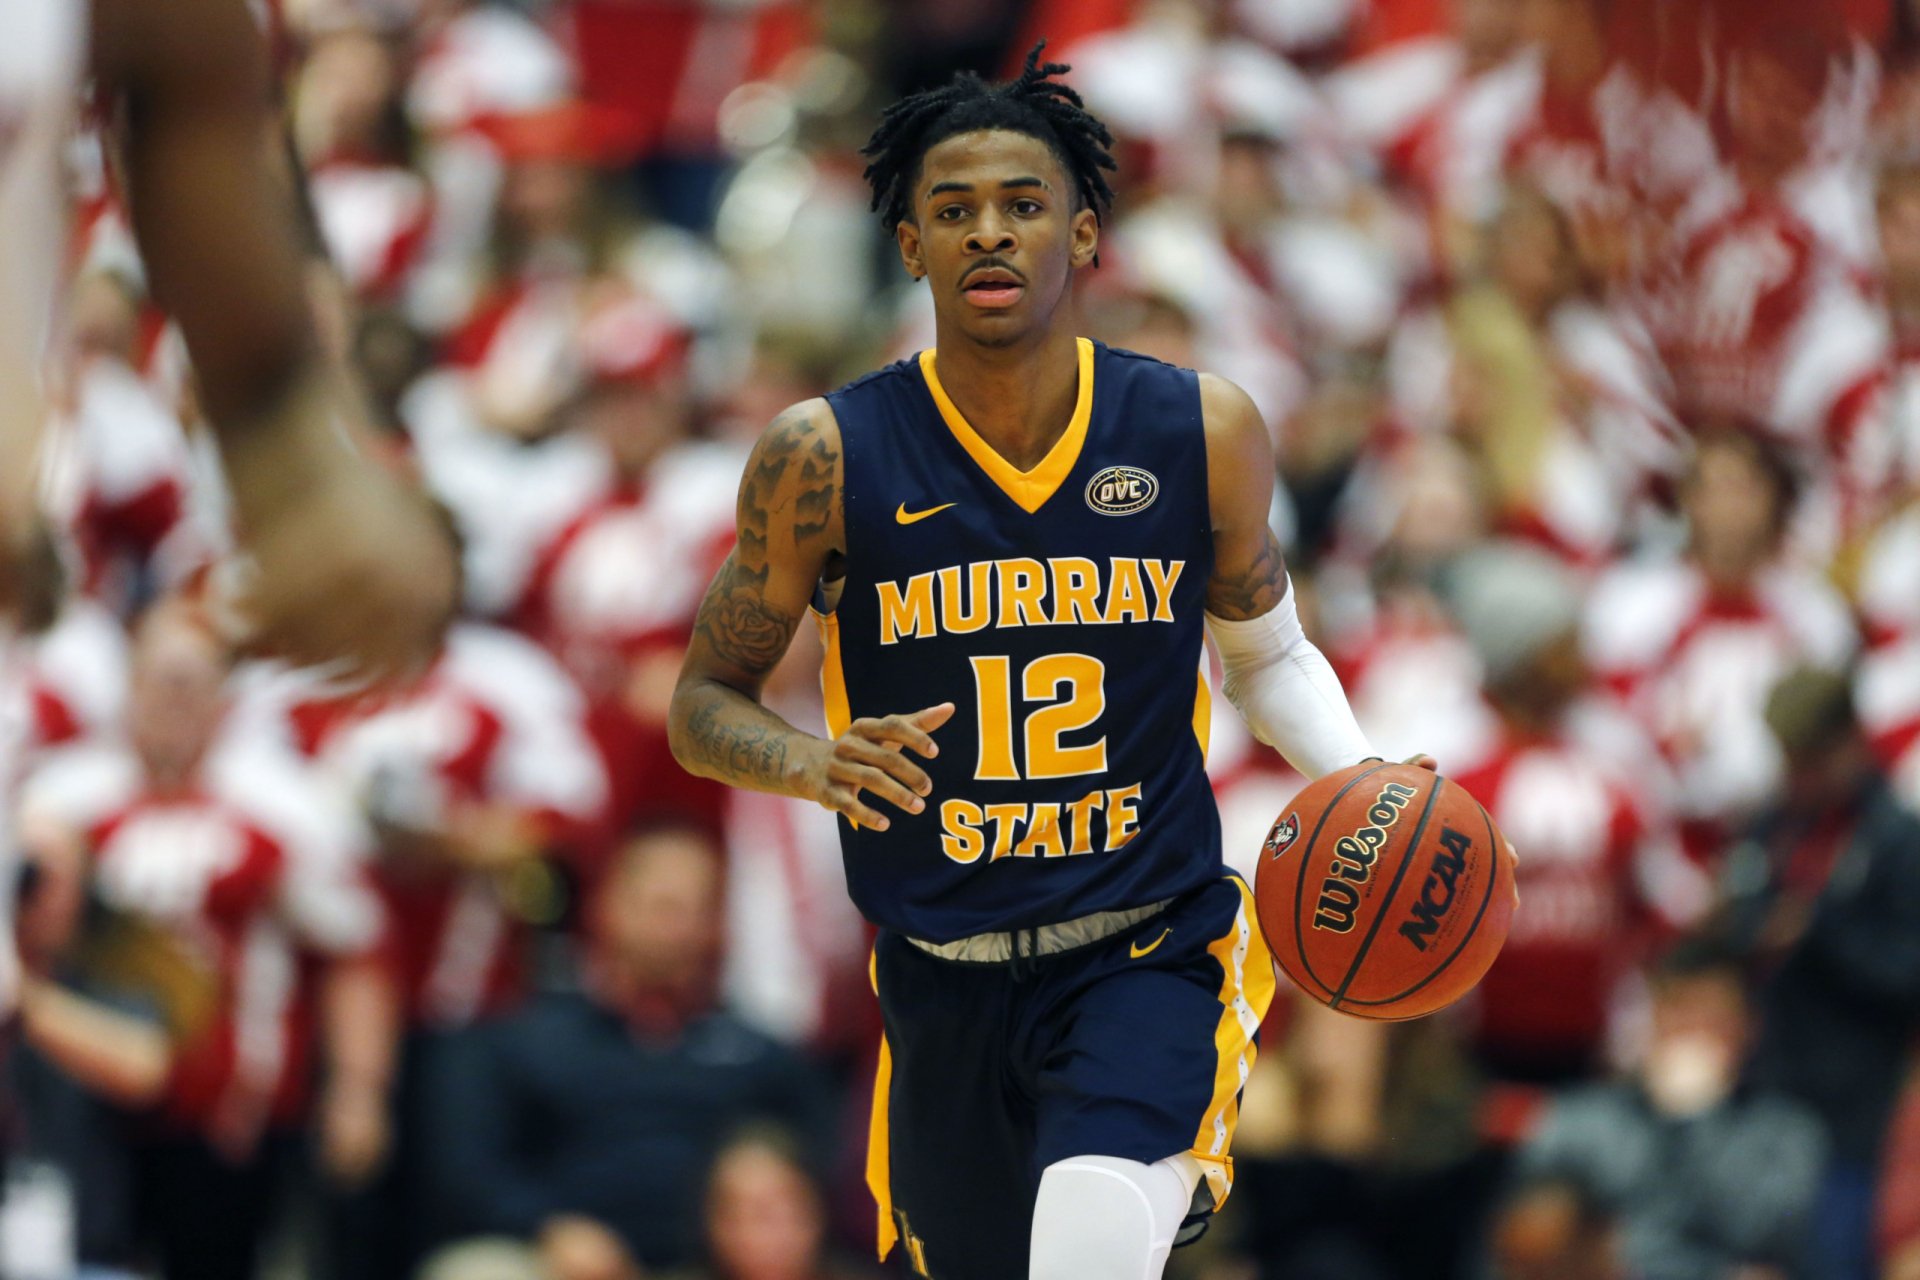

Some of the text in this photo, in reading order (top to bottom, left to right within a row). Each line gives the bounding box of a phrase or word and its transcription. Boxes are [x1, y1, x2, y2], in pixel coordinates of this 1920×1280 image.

[1101, 480, 1142, 502] OVC
[875, 557, 1186, 645] MURRAY
[968, 652, 1108, 781] 12
[940, 781, 1142, 864] STATE
[1312, 782, 1418, 934] Wilson
[1398, 827, 1472, 952] NCAA
